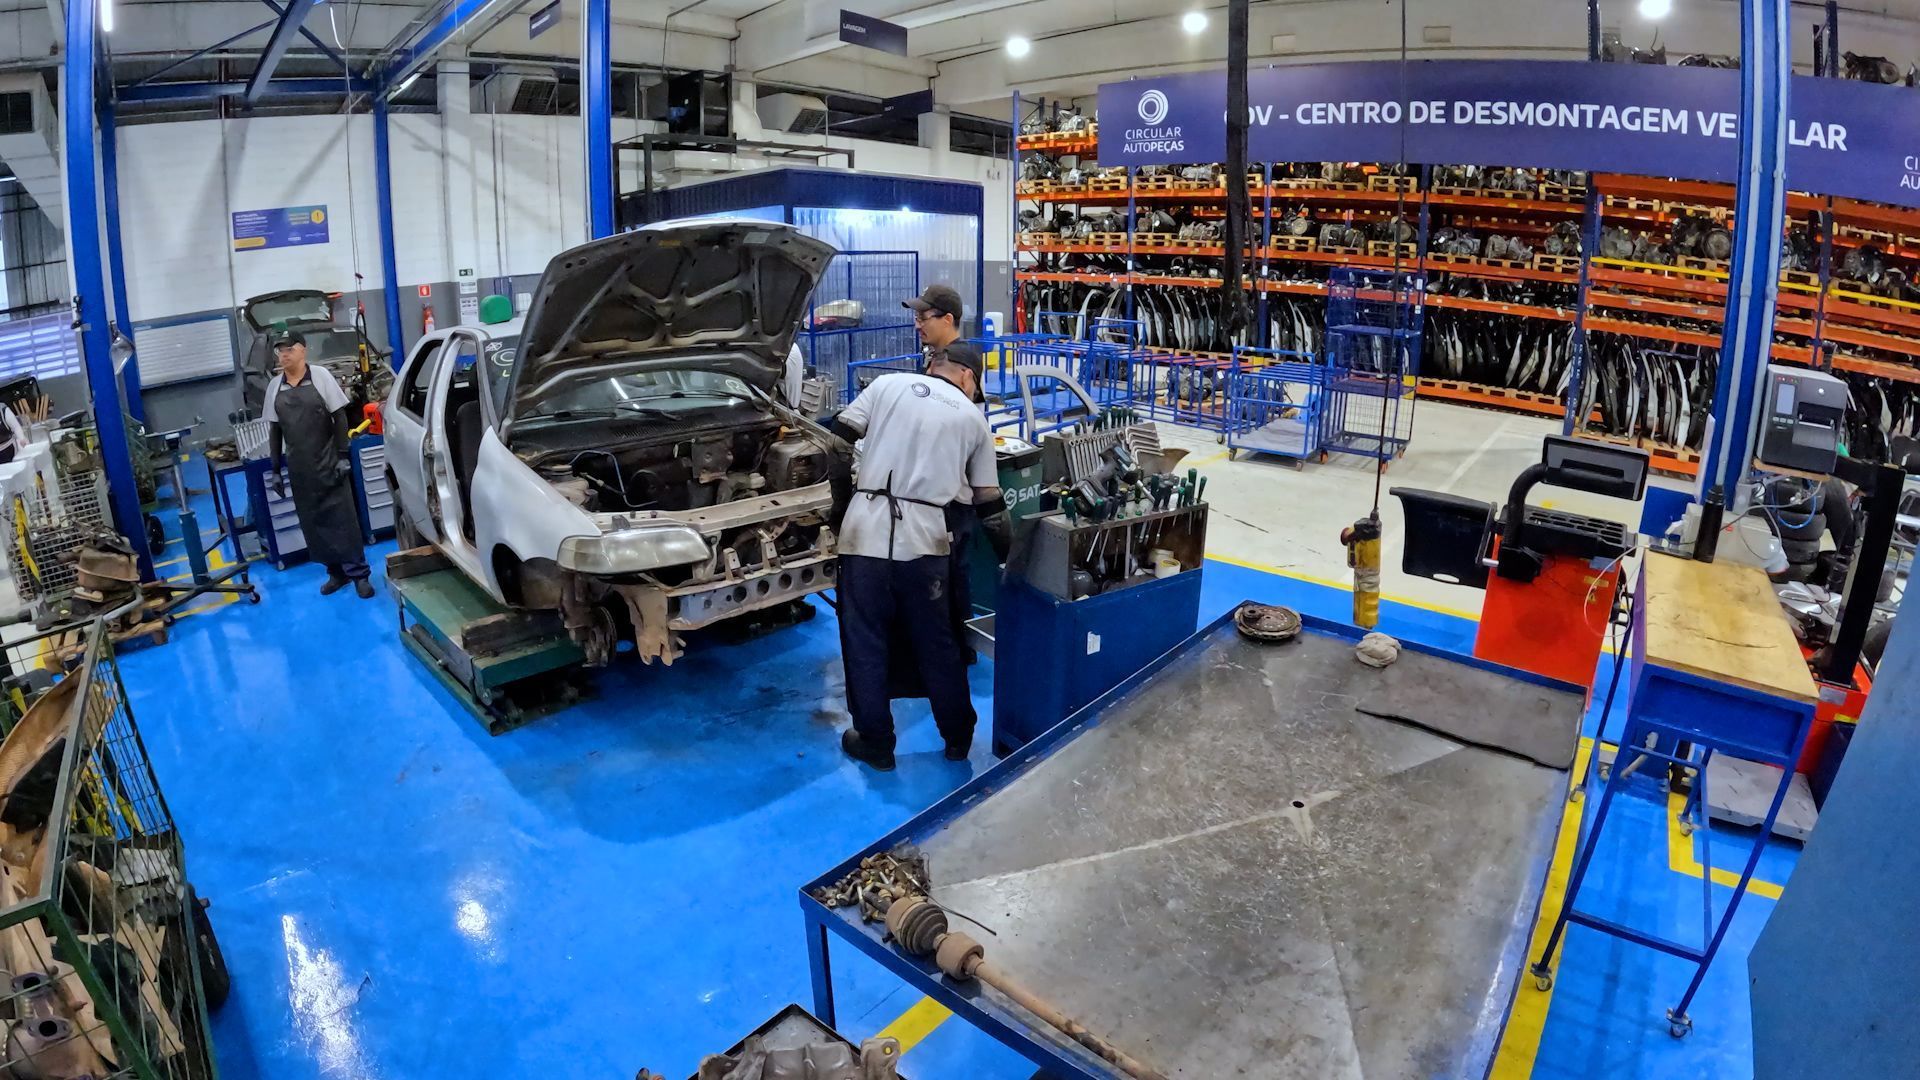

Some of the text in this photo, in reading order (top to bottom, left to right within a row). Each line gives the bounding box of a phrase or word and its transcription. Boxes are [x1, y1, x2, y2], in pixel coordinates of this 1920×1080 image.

[1125, 127, 1182, 140] CIRCULAR
[1296, 101, 1402, 125] CENTRO
[1409, 101, 1446, 124] DE
[1453, 101, 1688, 135] DESMONTAGEM
[1696, 111, 1848, 151] VELAR
[1123, 140, 1184, 154] AUTOPEÇAS
[1018, 483, 1041, 503] SAT
